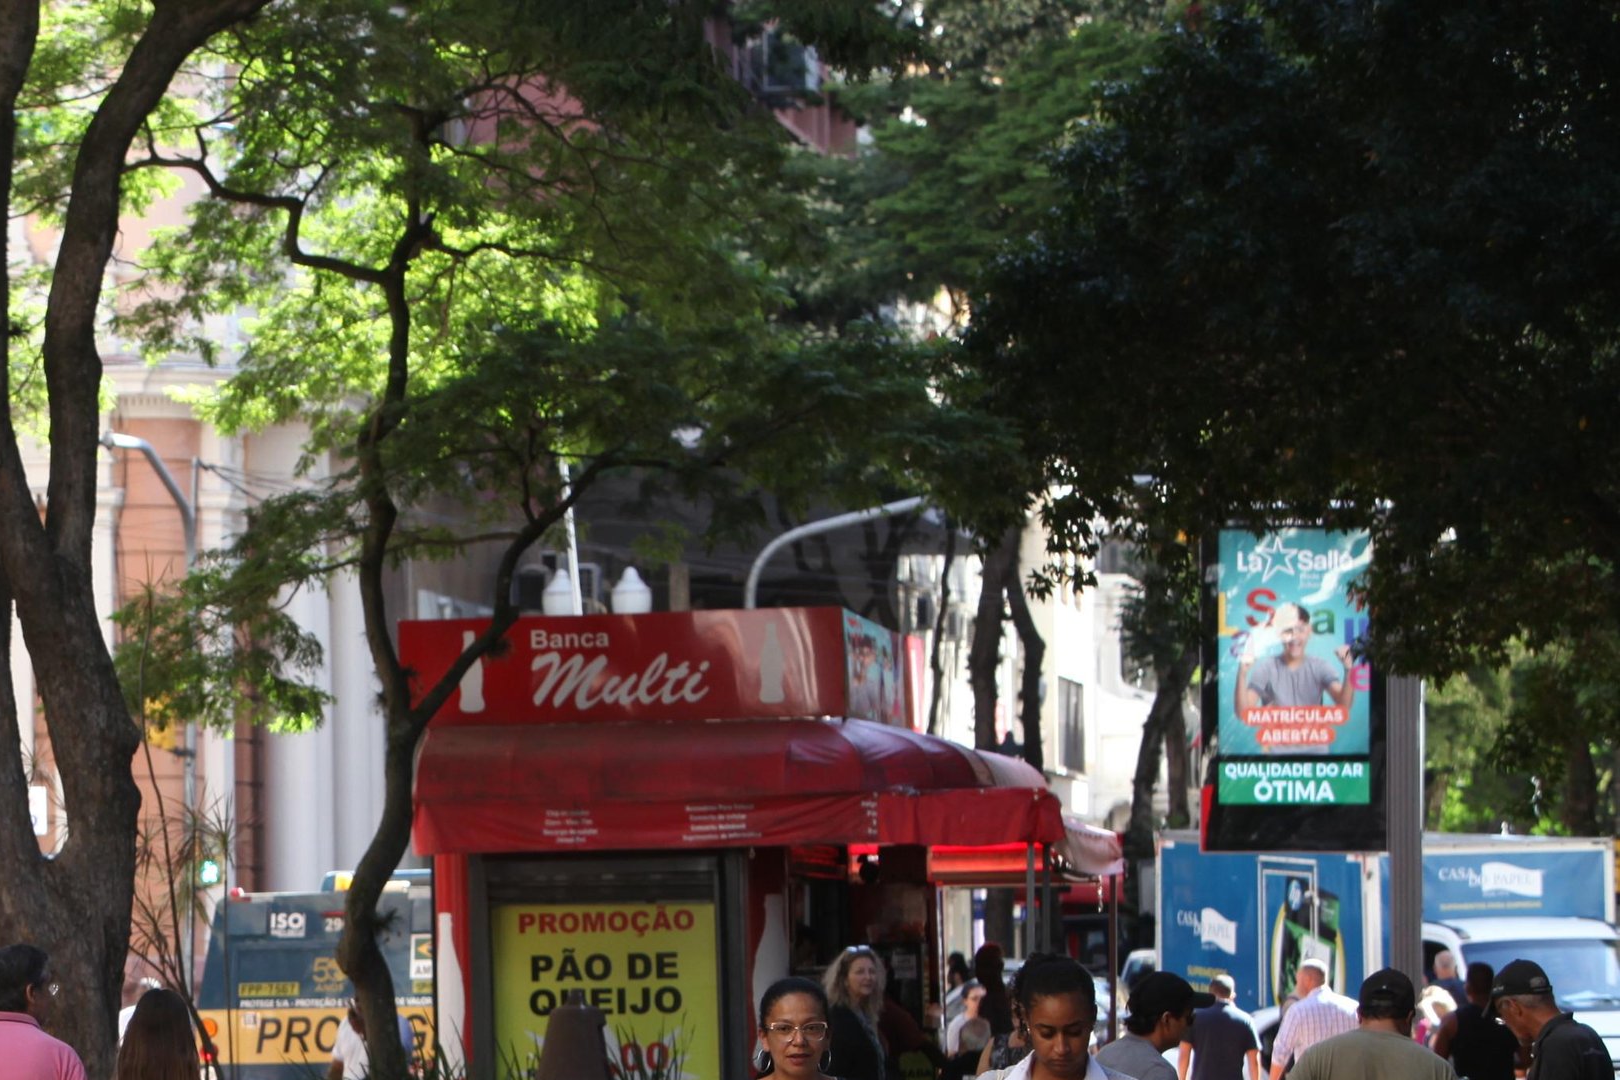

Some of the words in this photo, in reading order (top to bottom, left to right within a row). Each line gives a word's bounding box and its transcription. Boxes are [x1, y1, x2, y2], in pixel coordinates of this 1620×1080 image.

[1237, 551, 1262, 572] La
[530, 629, 609, 648] Banca
[532, 651, 710, 710] Multi
[1247, 708, 1343, 723] MATRÍCULAS
[1261, 728, 1329, 742] ABERTAS
[1225, 763, 1312, 779] QUALIDADE
[1316, 763, 1338, 777] DO
[1341, 763, 1363, 777] AR
[1254, 774, 1335, 802] ÓTIMA
[1438, 867, 1475, 881] CASA
[270, 912, 303, 929] ISO
[519, 905, 695, 938] PROMOÇÃO
[1177, 909, 1201, 927] CASA
[531, 948, 612, 982] PÃO
[627, 952, 679, 980] DE
